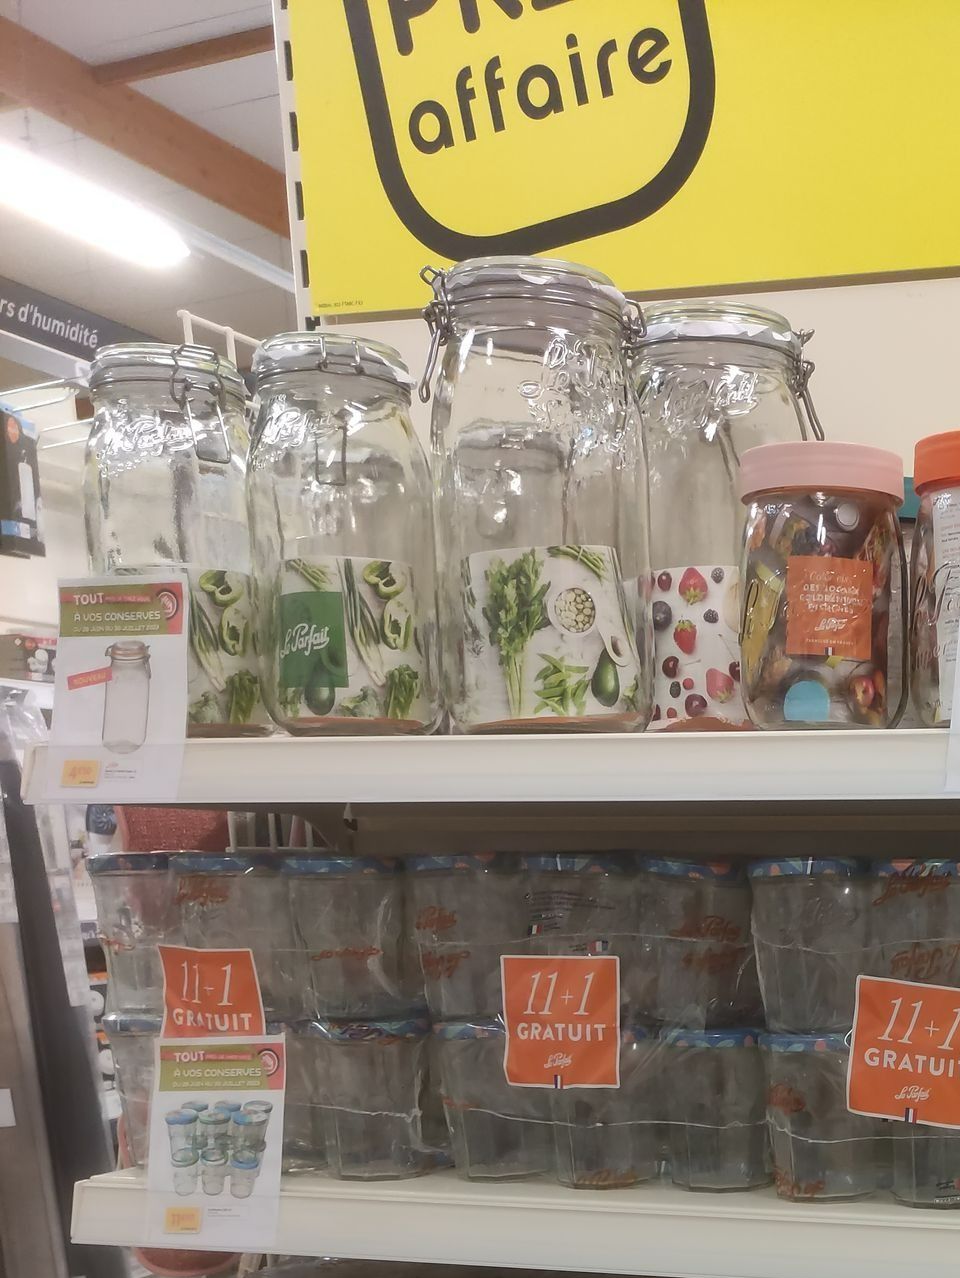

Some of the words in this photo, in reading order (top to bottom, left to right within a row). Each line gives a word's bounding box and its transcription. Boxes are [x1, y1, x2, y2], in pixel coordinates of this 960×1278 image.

[409, 27, 672, 154] affaire
[18, 303, 98, 348] d'humidité
[73, 592, 104, 606] TOUT
[83, 612, 102, 621] VOS
[104, 611, 160, 621] CONSERVES
[280, 629, 292, 659] Le
[291, 622, 330, 656] Parfait
[181, 960, 233, 1006] 11+1
[523, 971, 596, 1016] 11+1
[172, 1008, 253, 1031] GRATUIT
[516, 1022, 606, 1042] GRATUIT
[174, 1051, 205, 1063] TOUT
[182, 1068, 202, 1077] VOS
[204, 1067, 262, 1077] CONSERVES
